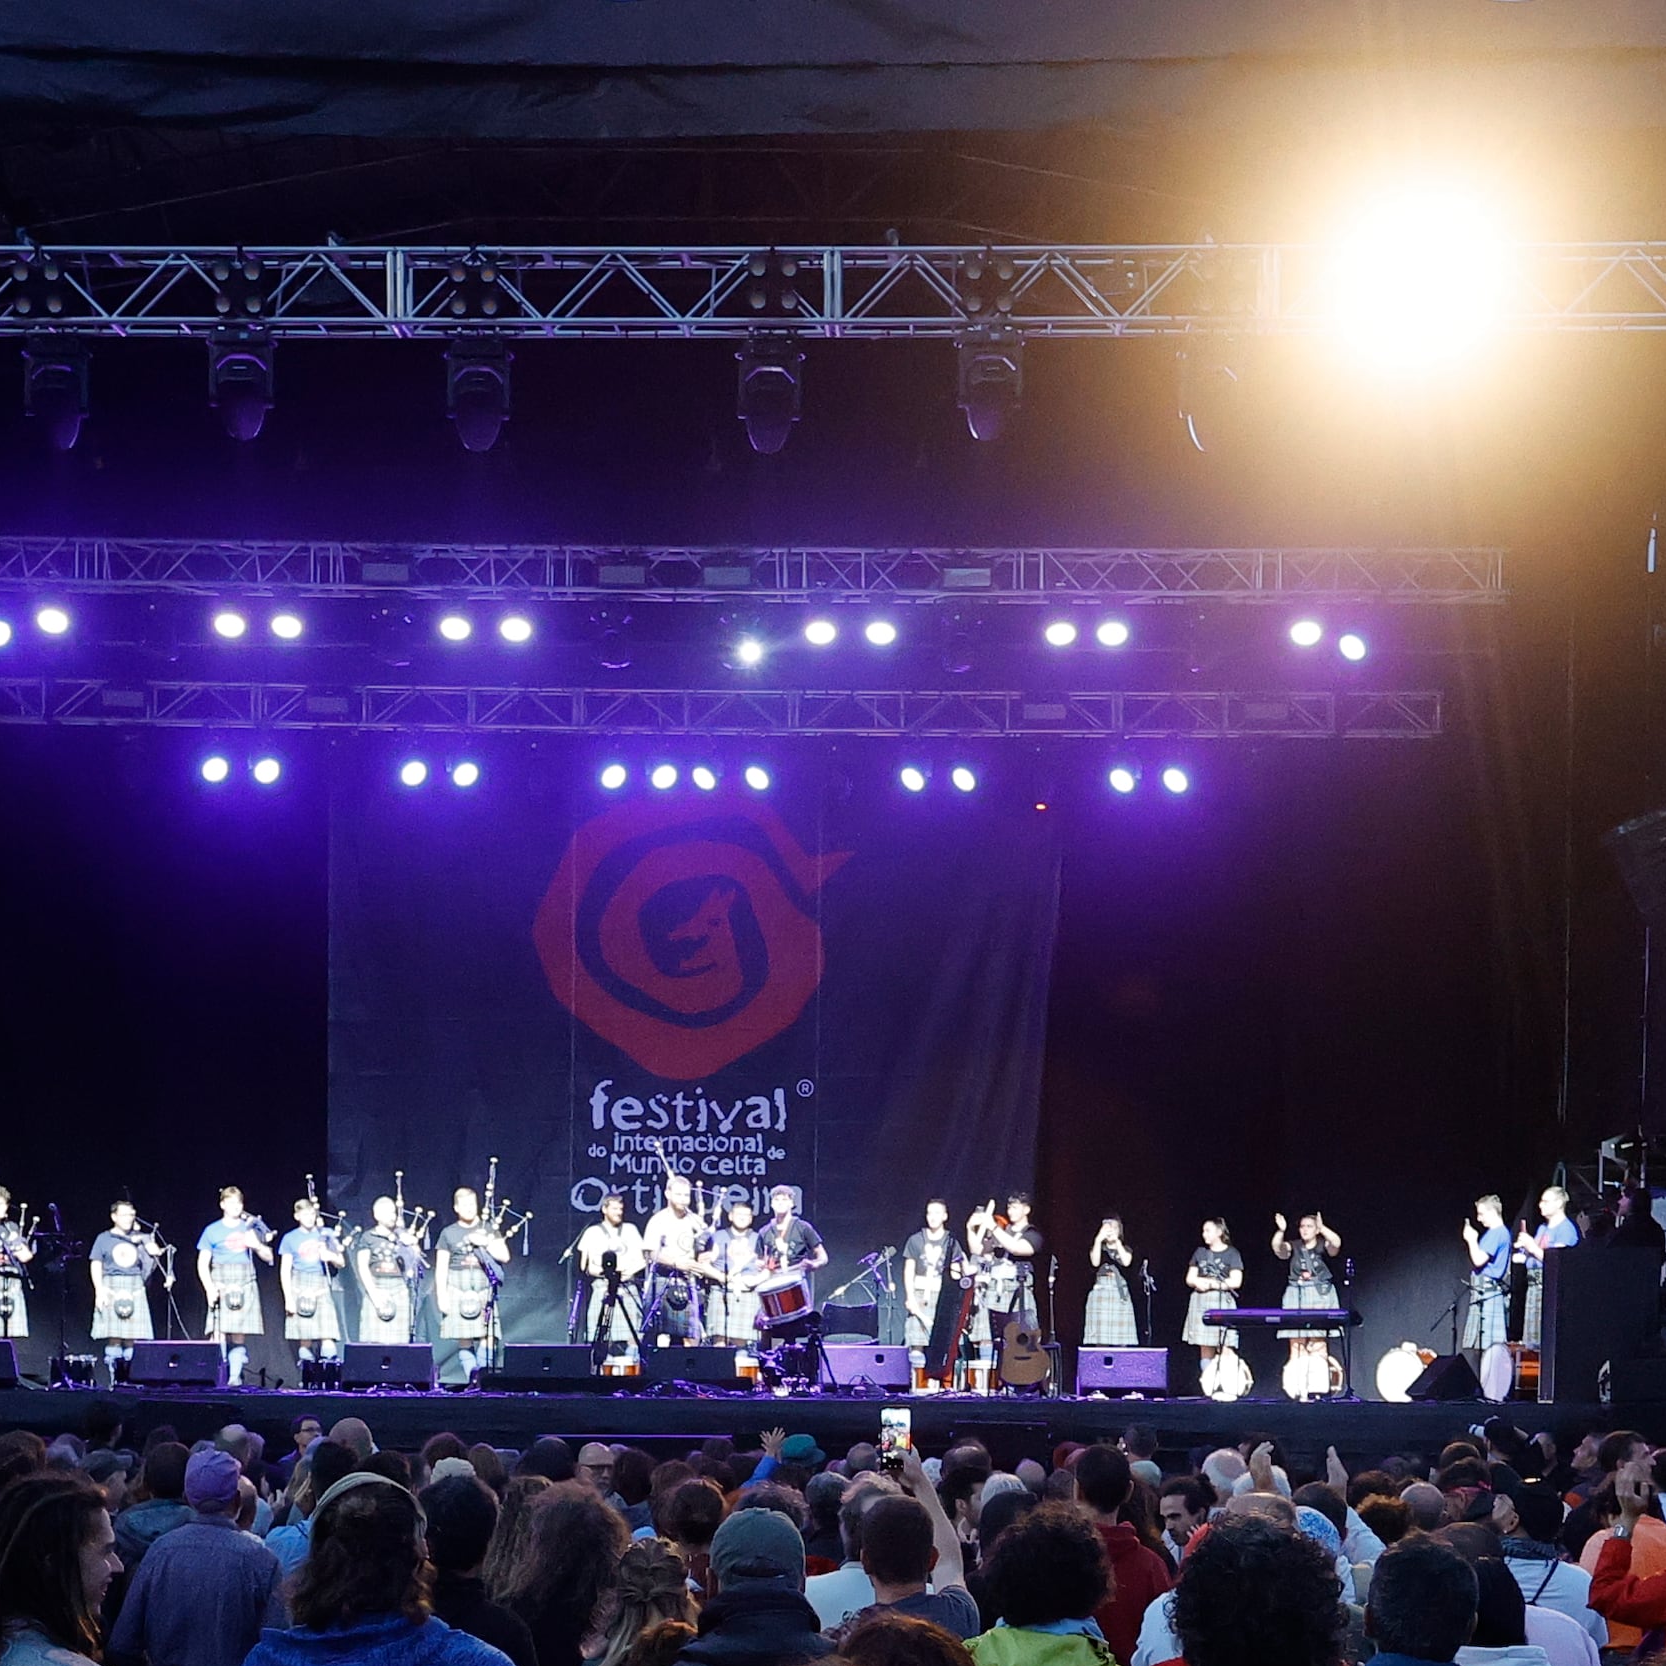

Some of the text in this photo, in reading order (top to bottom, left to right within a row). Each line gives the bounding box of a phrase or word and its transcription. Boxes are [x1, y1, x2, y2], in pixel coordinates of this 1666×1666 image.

[589, 1079, 788, 1133] festival
[588, 1143, 786, 1176] do Mundo Celta de
[613, 1132, 763, 1154] internacional
